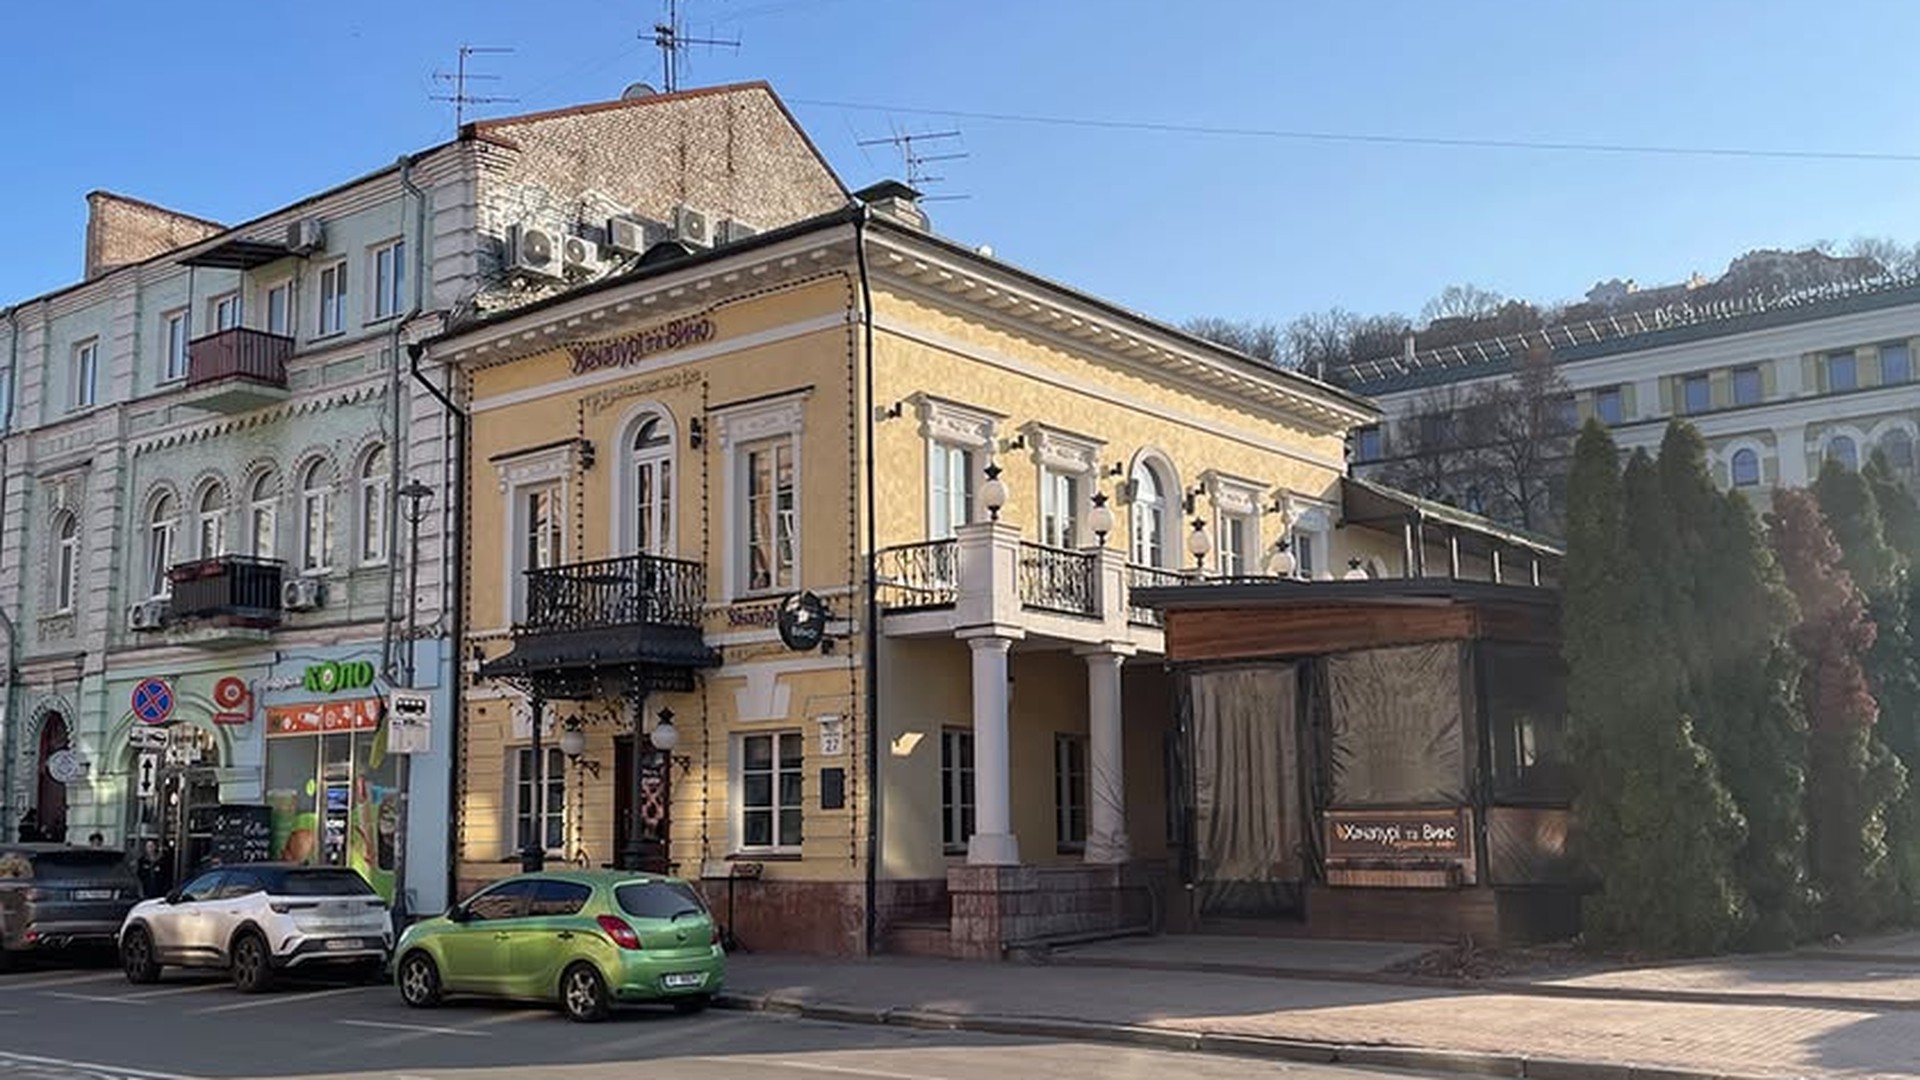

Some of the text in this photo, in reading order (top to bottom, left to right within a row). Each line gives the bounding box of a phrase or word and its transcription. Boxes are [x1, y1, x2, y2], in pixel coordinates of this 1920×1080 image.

[305, 660, 374, 693] КОЛО
[825, 738, 840, 753] 27
[1343, 823, 1401, 845] Хачапурі
[1422, 823, 1457, 841] Вино
